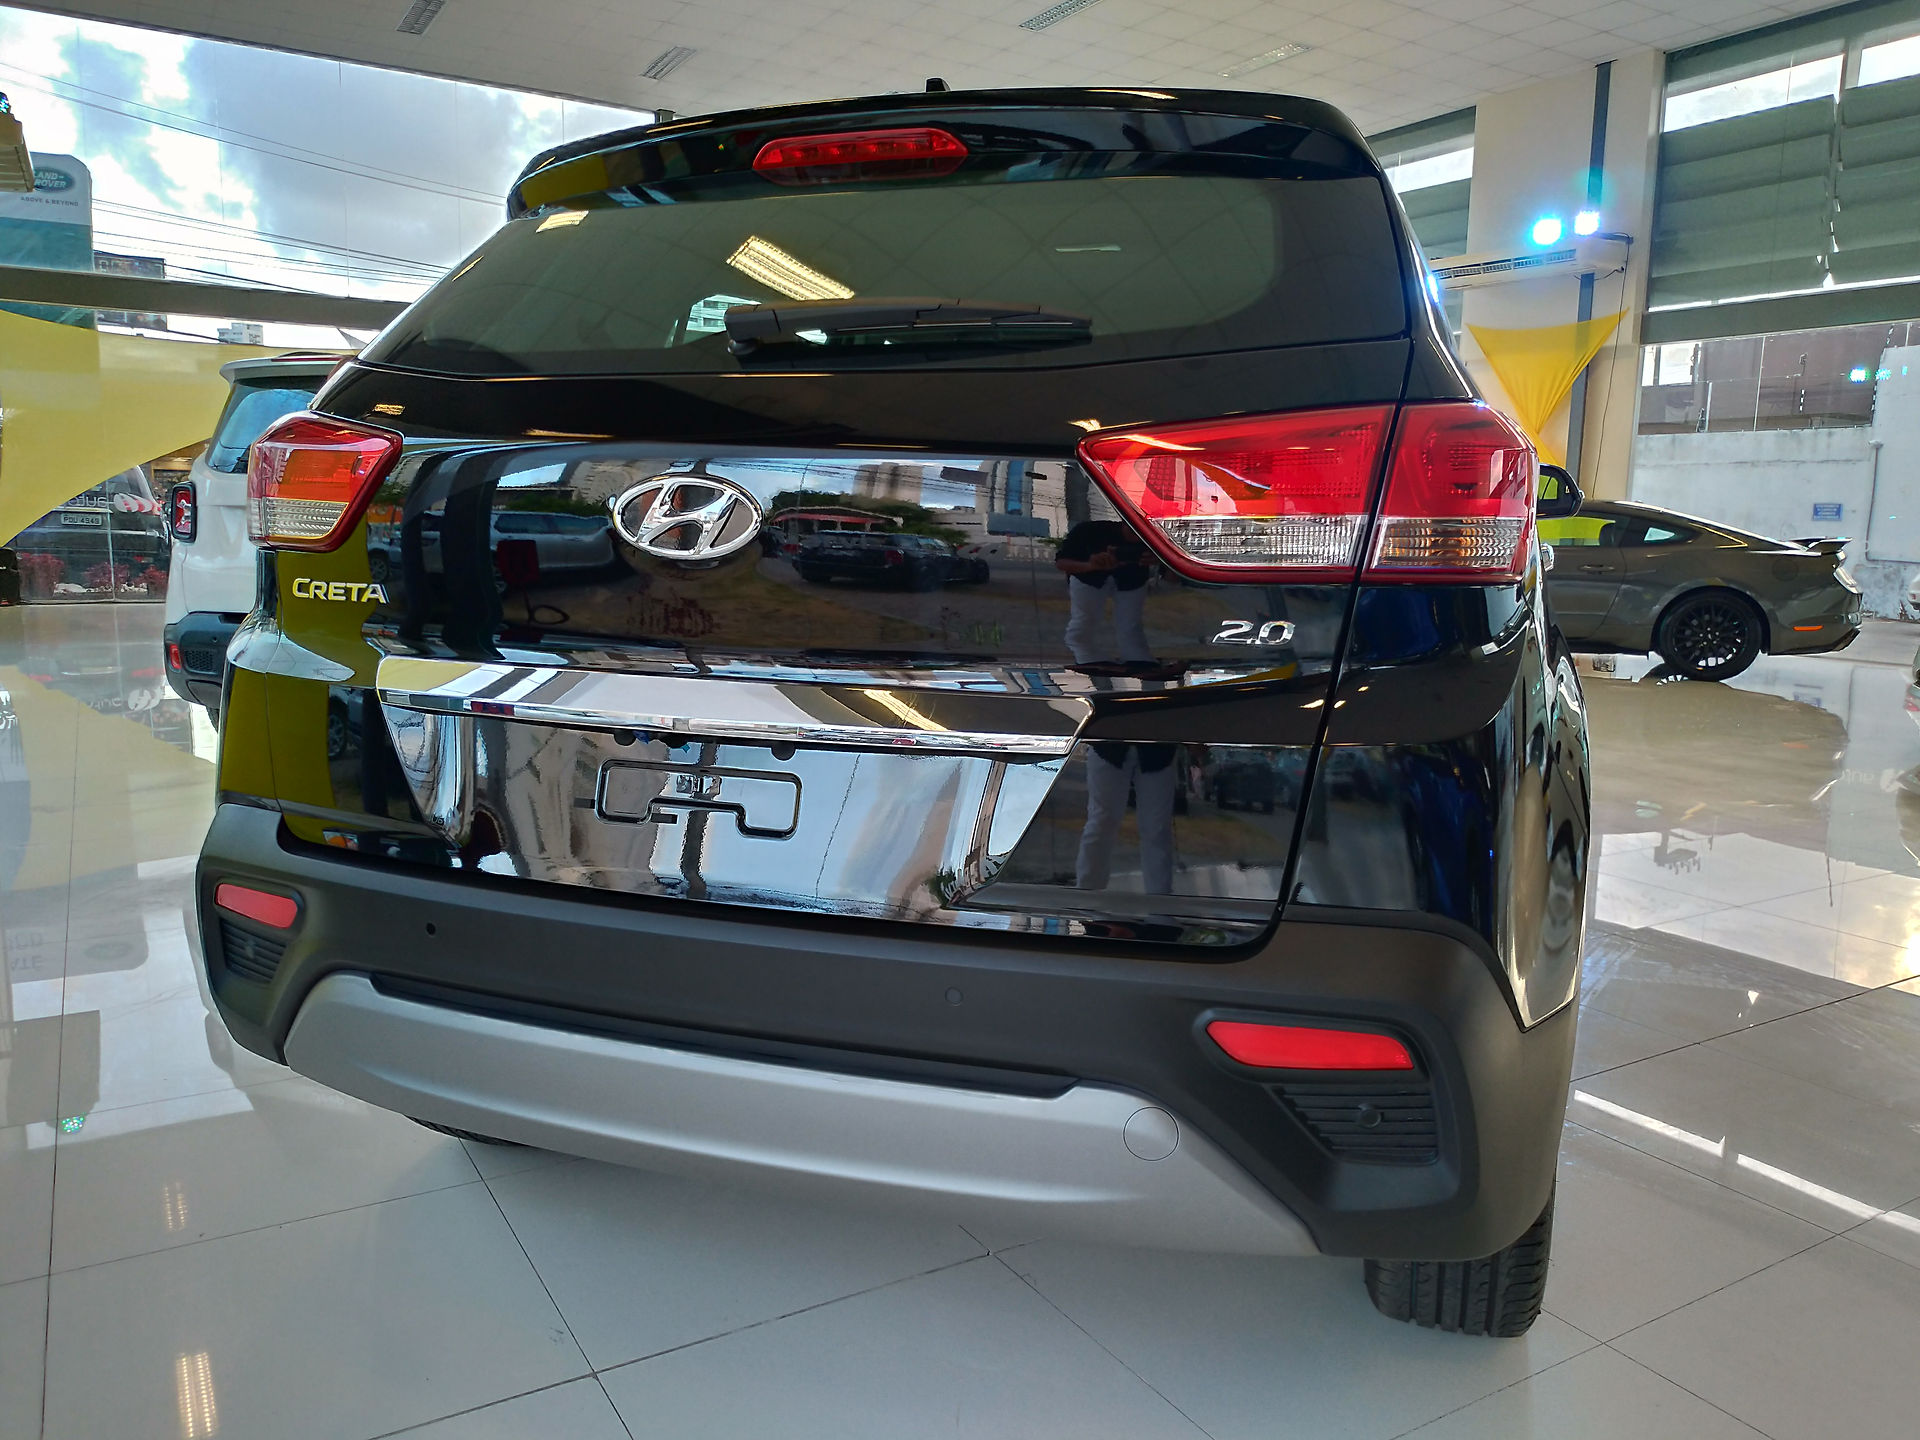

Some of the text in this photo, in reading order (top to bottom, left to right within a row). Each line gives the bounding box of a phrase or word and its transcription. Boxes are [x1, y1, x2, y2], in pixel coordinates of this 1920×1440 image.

[34, 179, 67, 188] ROVER
[291, 577, 387, 604] CRETA
[1211, 619, 1296, 645] 2.0
